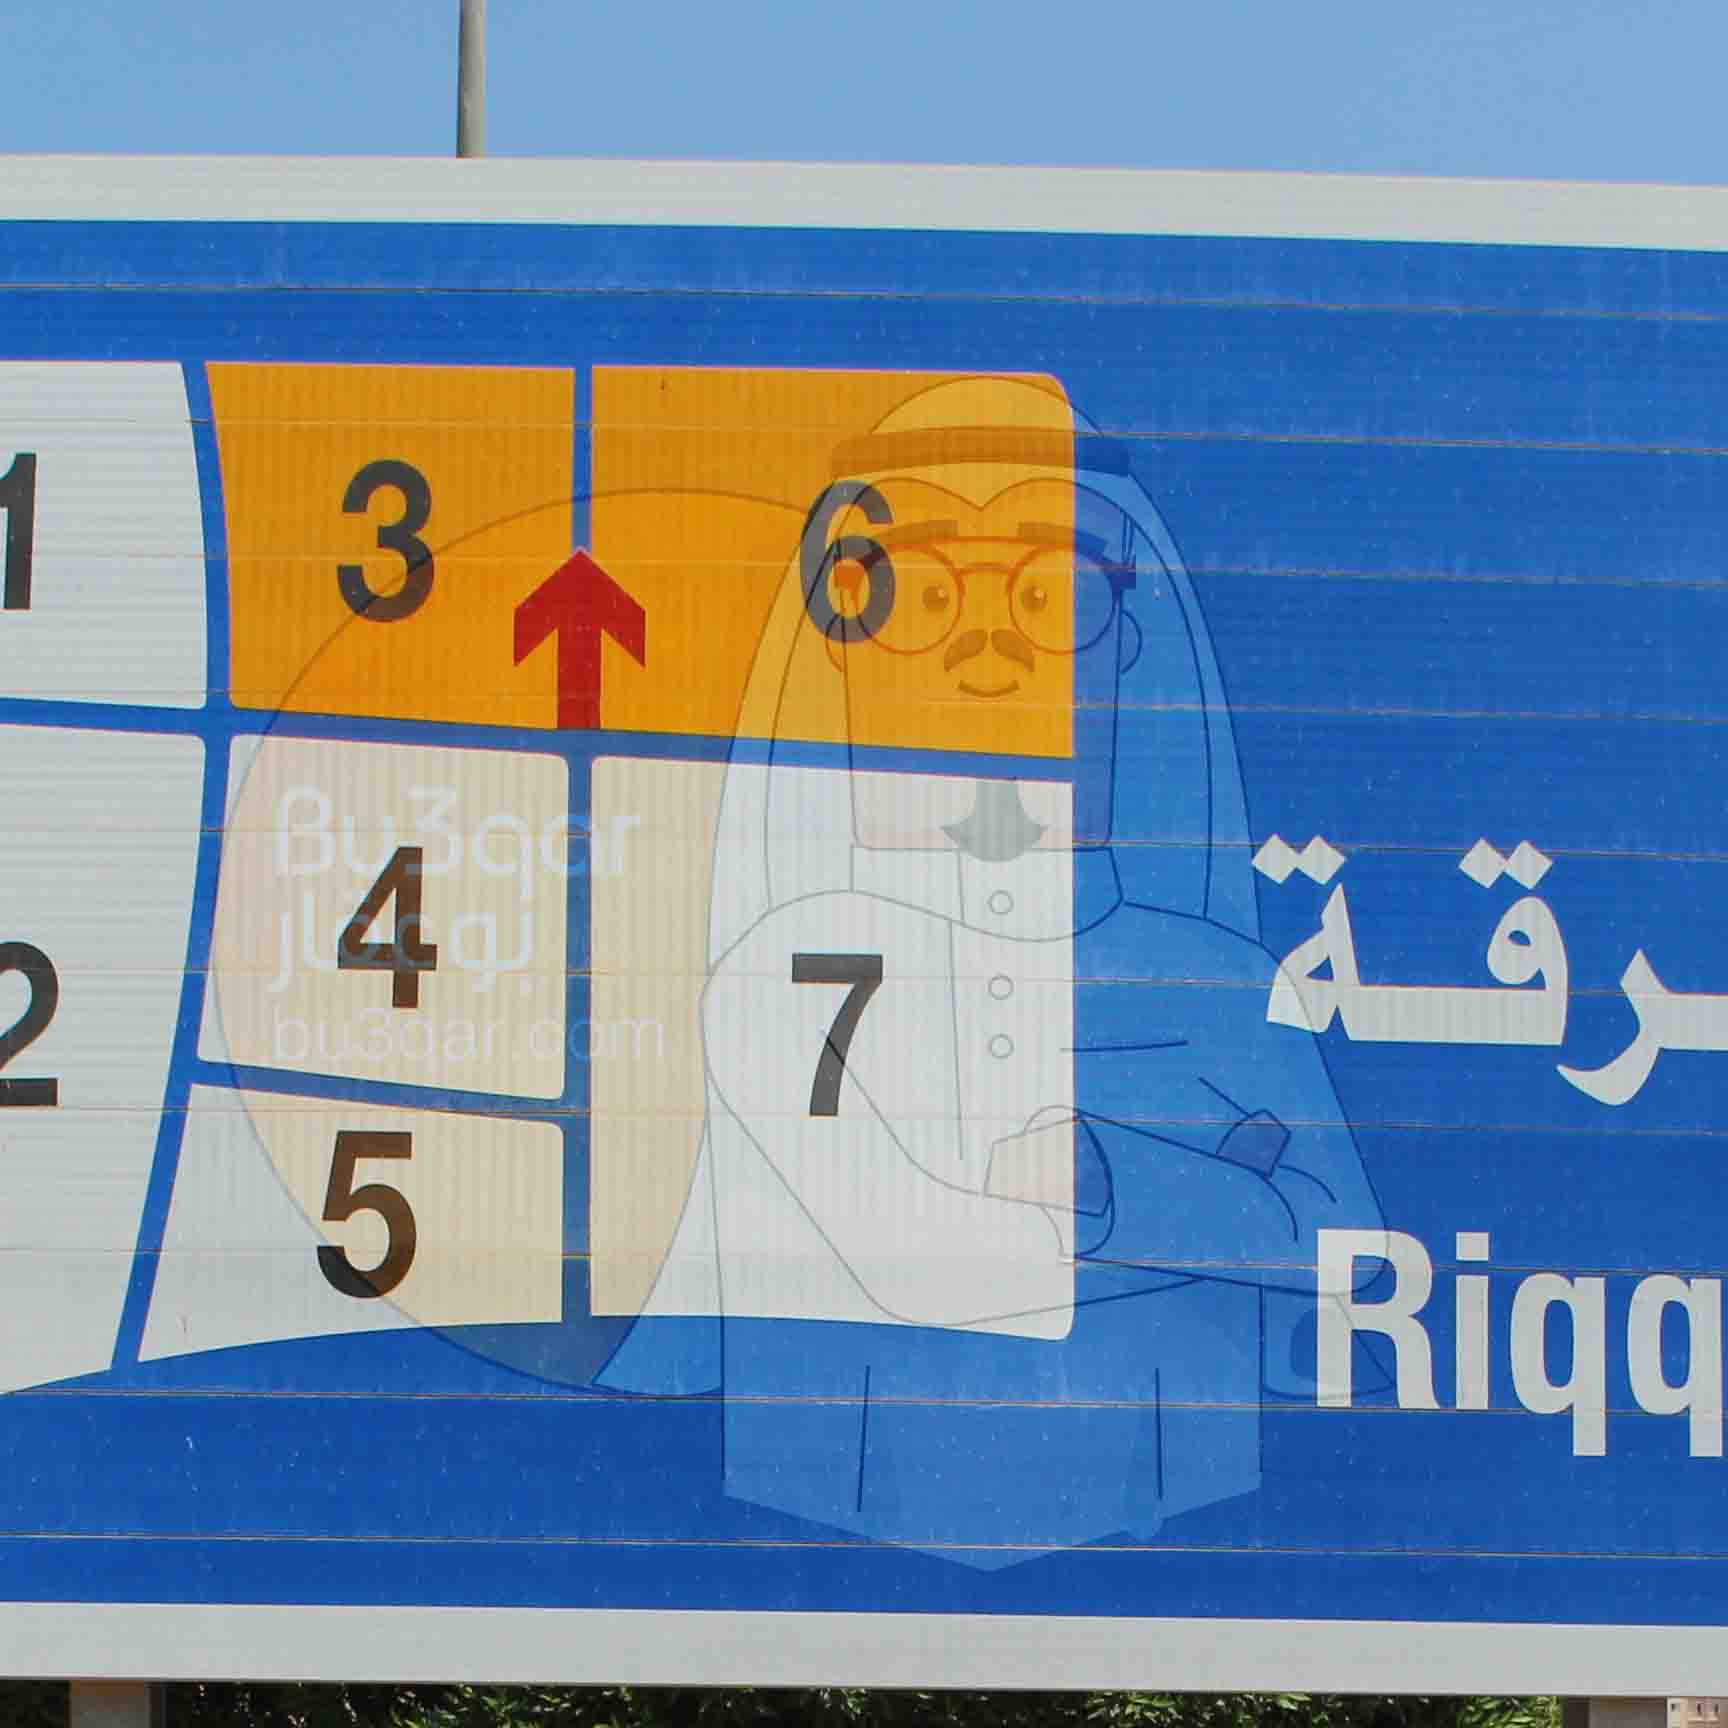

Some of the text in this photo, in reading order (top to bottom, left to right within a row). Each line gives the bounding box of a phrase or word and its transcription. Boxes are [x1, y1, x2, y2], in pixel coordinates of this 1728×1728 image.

[337, 460, 435, 623] 3
[799, 480, 896, 643] 6
[337, 846, 437, 1008] 4
[791, 952, 884, 1117] 7
[316, 1130, 418, 1300] 5
